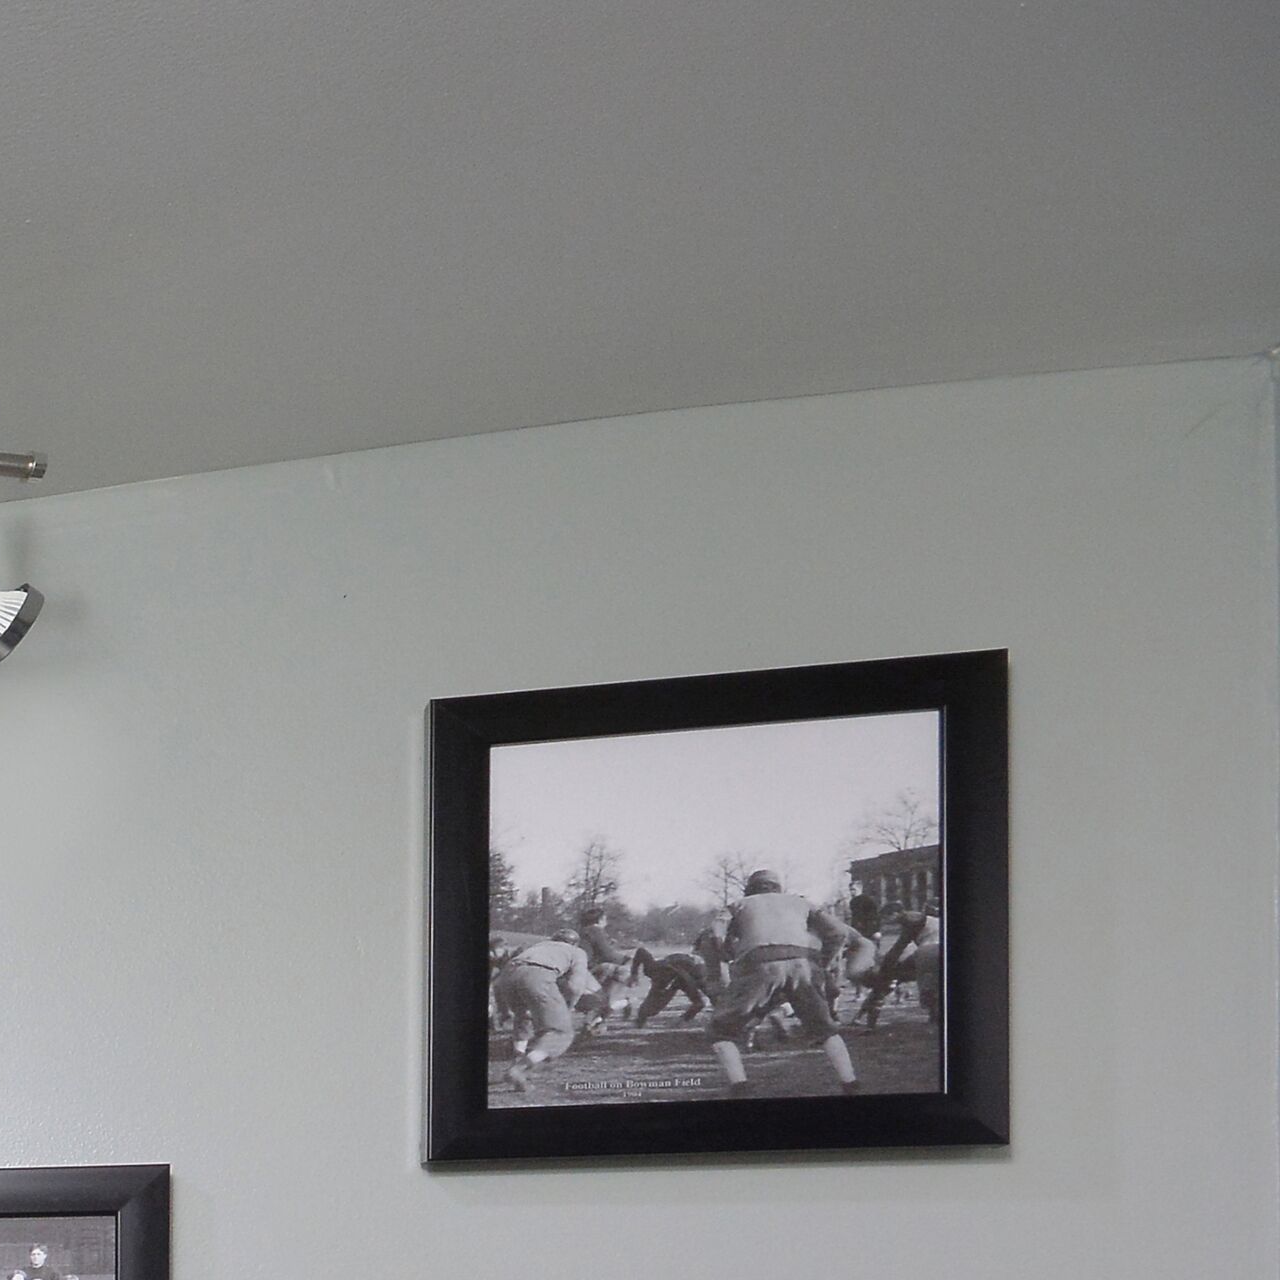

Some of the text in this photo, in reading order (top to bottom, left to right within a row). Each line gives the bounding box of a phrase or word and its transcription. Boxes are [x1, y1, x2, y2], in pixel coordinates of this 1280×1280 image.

[565, 1081, 607, 1090] Football
[626, 1079, 671, 1089] Bowman
[674, 1077, 702, 1088] Field
